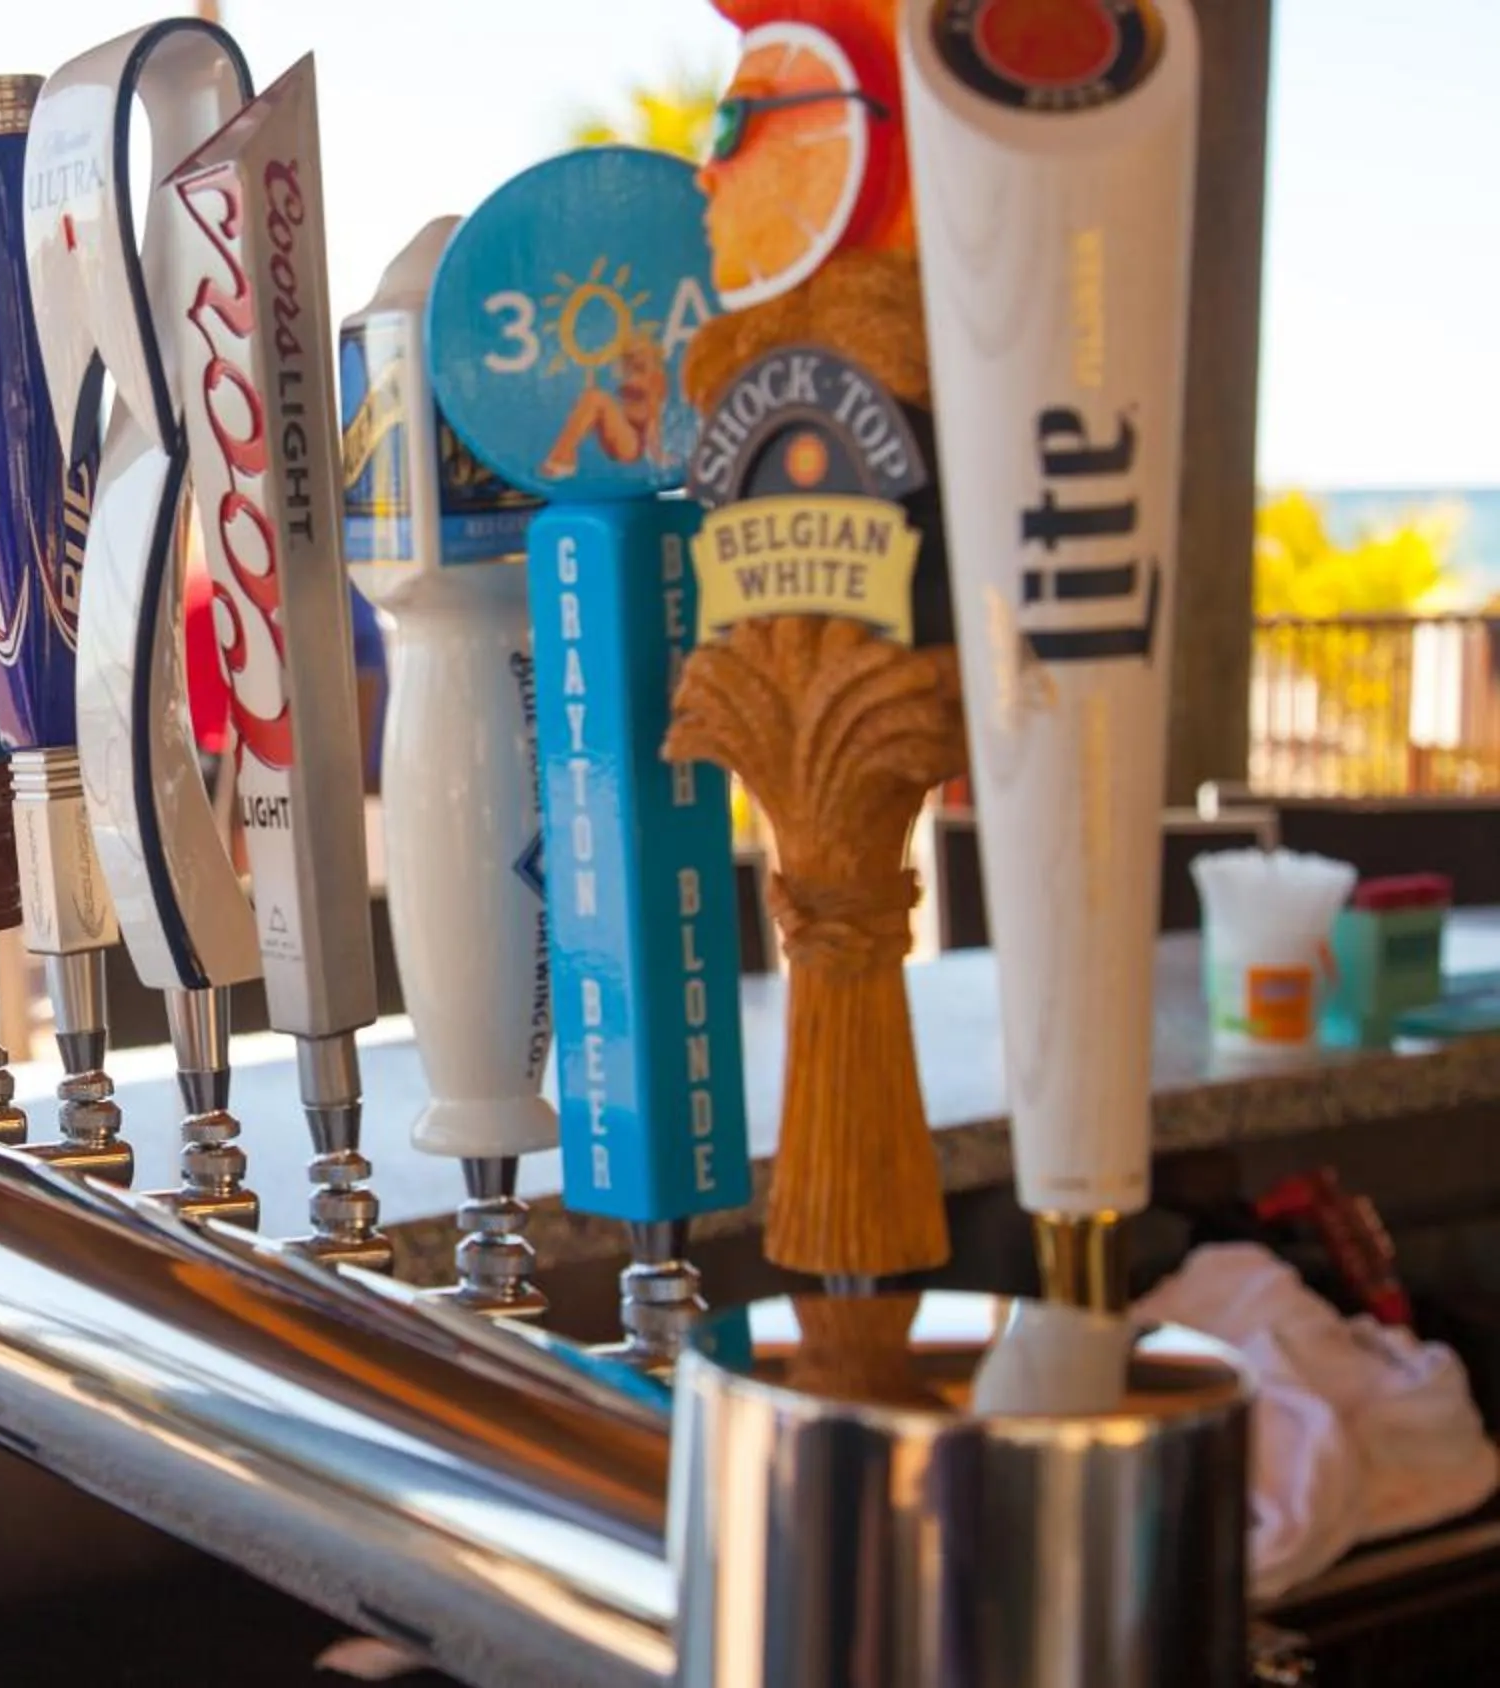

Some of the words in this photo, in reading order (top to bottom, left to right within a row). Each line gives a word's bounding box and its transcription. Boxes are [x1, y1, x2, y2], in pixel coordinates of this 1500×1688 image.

[28, 157, 106, 211] ULTRA
[263, 157, 306, 366] Coors
[278, 367, 315, 545] LIGHT
[697, 356, 820, 493] SHOCK
[835, 371, 908, 478] TOP
[714, 512, 892, 564] BELGIAN
[735, 560, 868, 602] WHITE
[1021, 405, 1160, 667] Lite
[243, 796, 290, 829] LIGHT
[557, 536, 598, 917] GRAYTON
[581, 978, 612, 1189] BEER
[677, 867, 715, 1192] BLONDE
